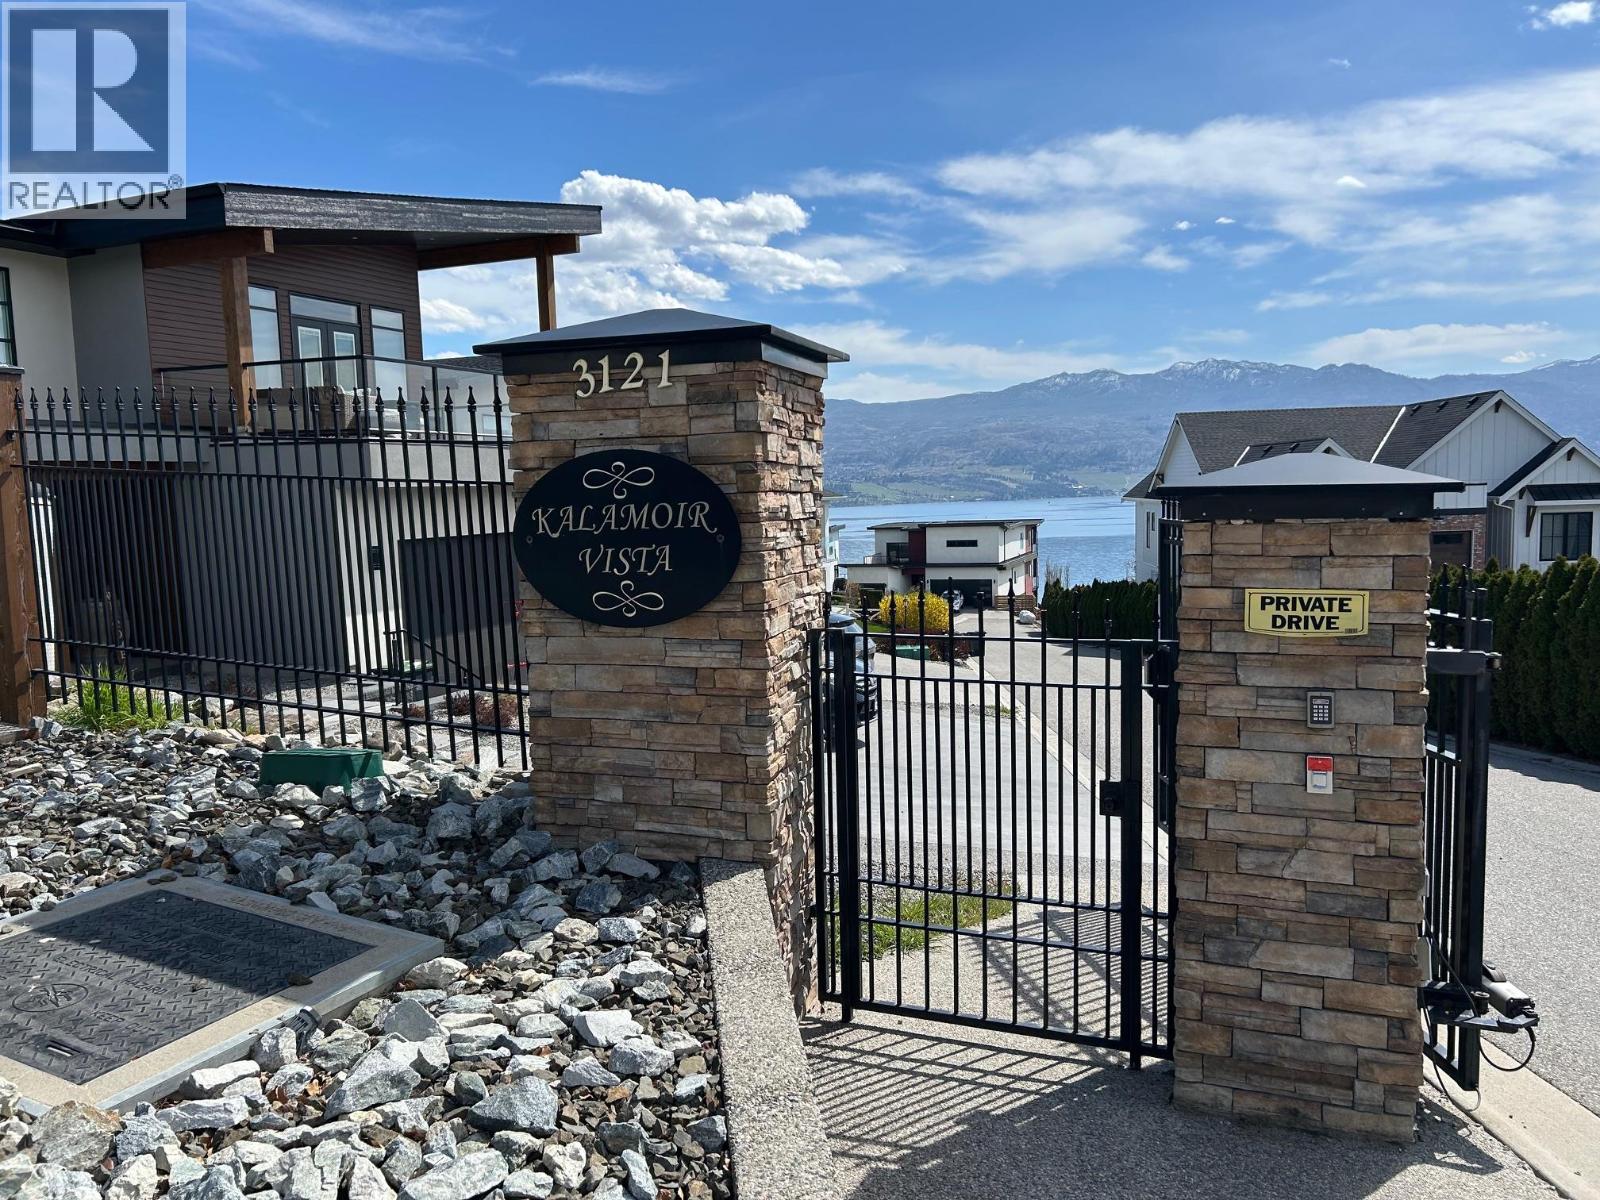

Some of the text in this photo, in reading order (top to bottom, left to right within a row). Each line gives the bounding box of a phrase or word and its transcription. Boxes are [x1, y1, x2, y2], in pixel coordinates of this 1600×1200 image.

[573, 350, 673, 398] 3121
[532, 501, 717, 538] KALAMOIR
[578, 544, 673, 576] VISTA
[1260, 595, 1352, 613] PRIVATE
[1271, 614, 1340, 630] DRIVE
[52, 955, 169, 995] ELECTRICAL HAZARD
[91, 1010, 156, 1033] KEEP OUT
